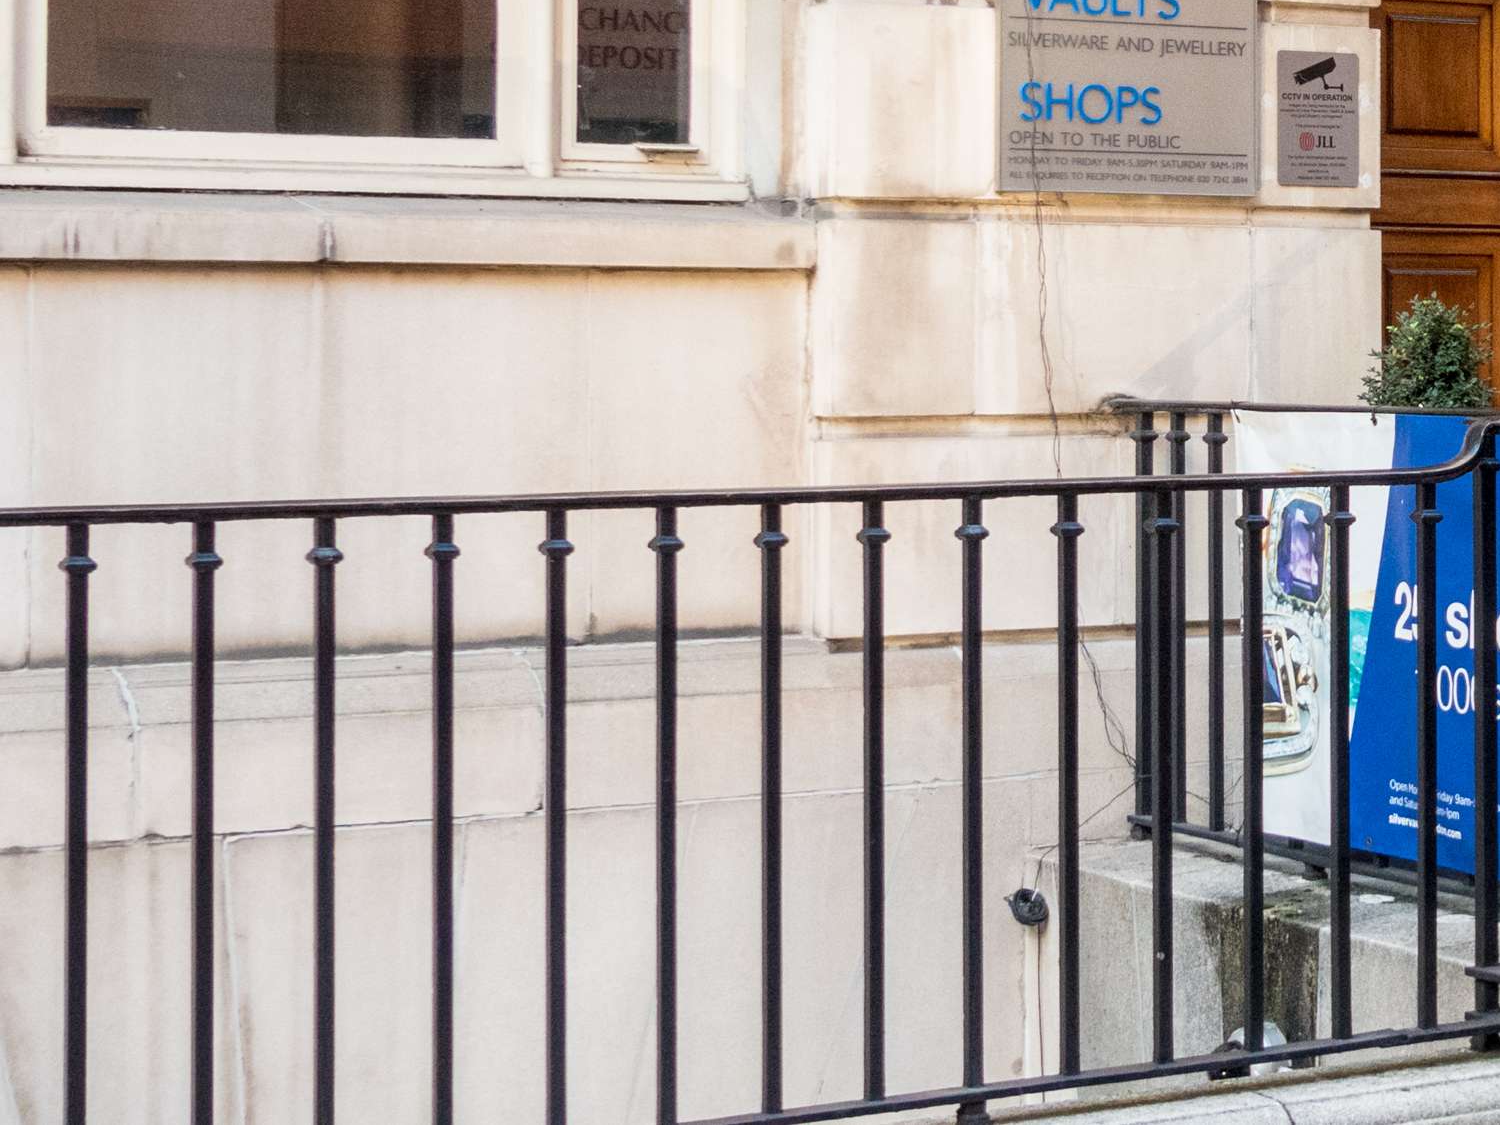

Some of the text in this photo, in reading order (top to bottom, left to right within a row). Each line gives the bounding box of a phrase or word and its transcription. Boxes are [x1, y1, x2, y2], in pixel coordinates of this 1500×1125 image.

[1008, 31, 1247, 58] SILVERWARE AND JEWELLERY
[1019, 81, 1163, 125] SHOPS
[1311, 94, 1353, 102] OPERATION
[1009, 130, 1181, 149] OPEN TO THE PUBLIC
[1009, 156, 1050, 166] MONDAY
[1055, 157, 1068, 165] TO
[1071, 157, 1102, 166] FRIDAY
[1160, 159, 1206, 170] SATURDAY
[1389, 779, 1408, 792] Open
[1389, 796, 1403, 805] and
